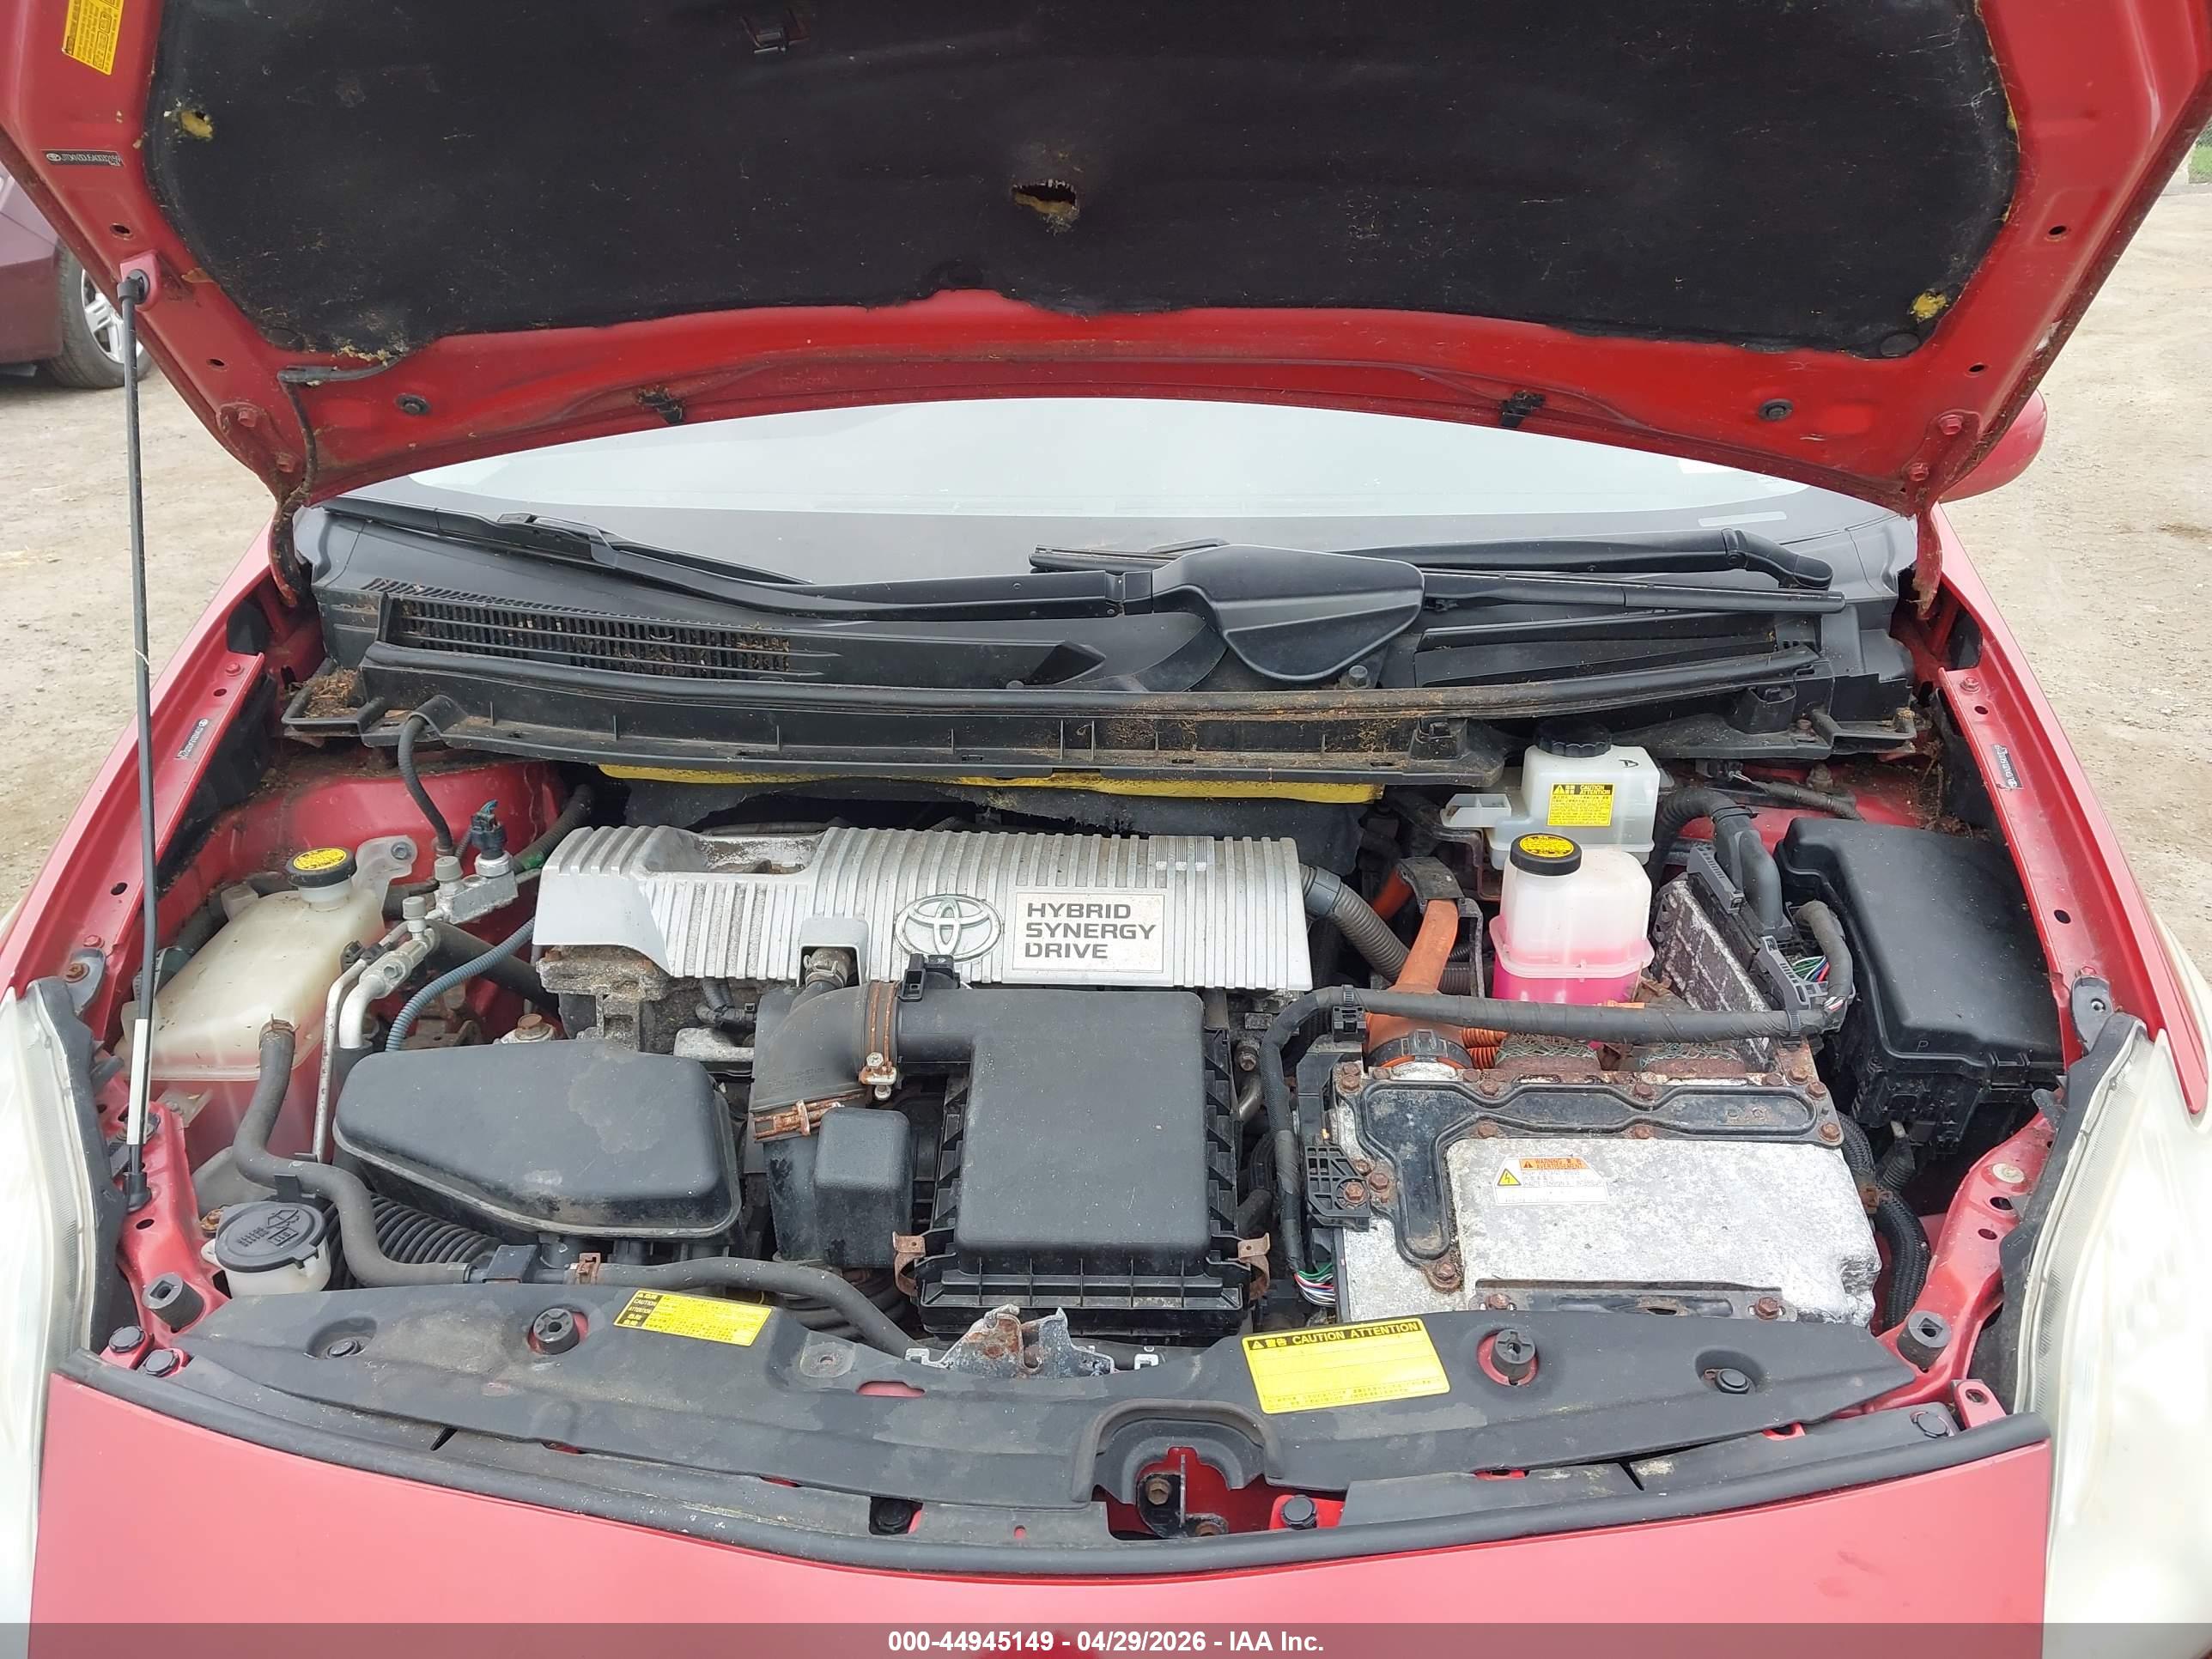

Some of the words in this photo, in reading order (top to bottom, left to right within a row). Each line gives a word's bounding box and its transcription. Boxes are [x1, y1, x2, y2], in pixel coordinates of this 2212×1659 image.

[1027, 902, 1132, 920] HYBRID
[1025, 922, 1157, 940] SYNERGY
[1024, 943, 1108, 959] DRIVE
[1291, 1331, 1346, 1346] CAUTION
[1350, 1322, 1419, 1339] ATTENTION
